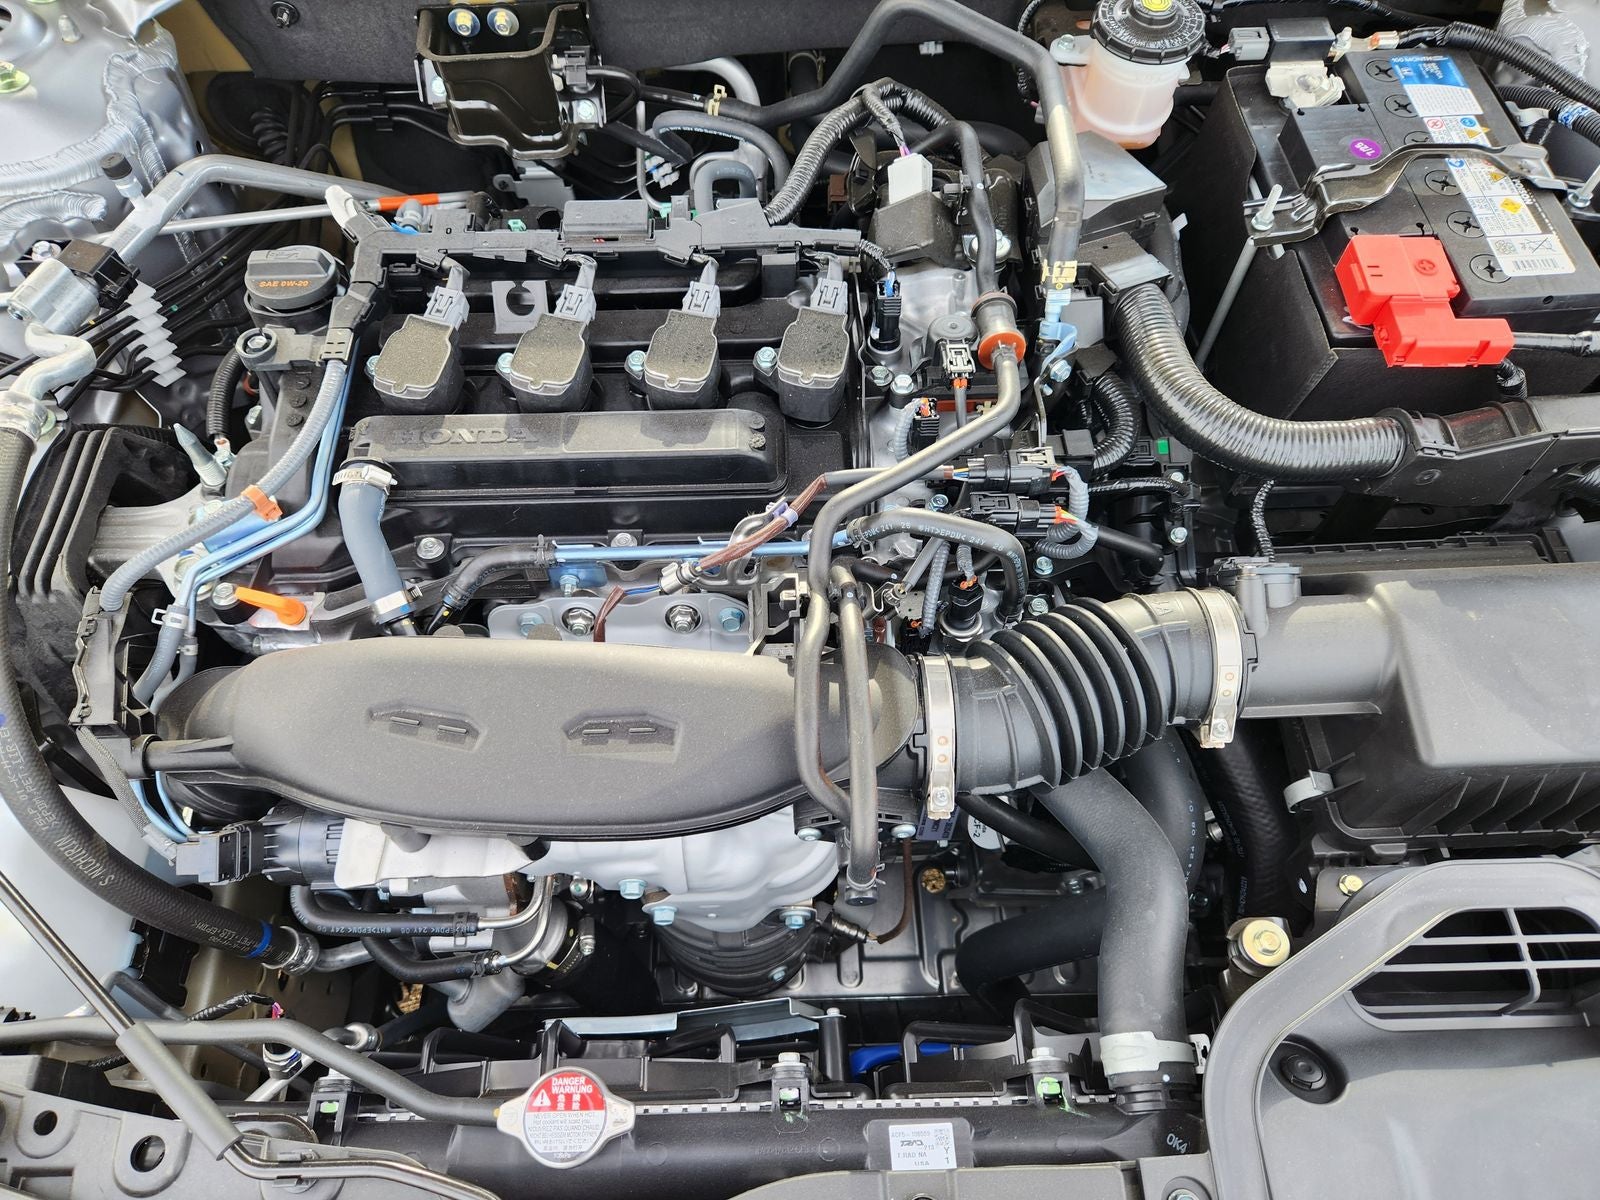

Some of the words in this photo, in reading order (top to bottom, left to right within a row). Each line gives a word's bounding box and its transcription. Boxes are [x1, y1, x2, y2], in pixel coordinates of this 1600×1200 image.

[259, 280, 279, 288] SAE
[280, 280, 310, 288] 0W-20
[392, 426, 538, 447] HONDA
[551, 1077, 585, 1085] DANGER
[551, 1085, 593, 1094] WARNUNG
